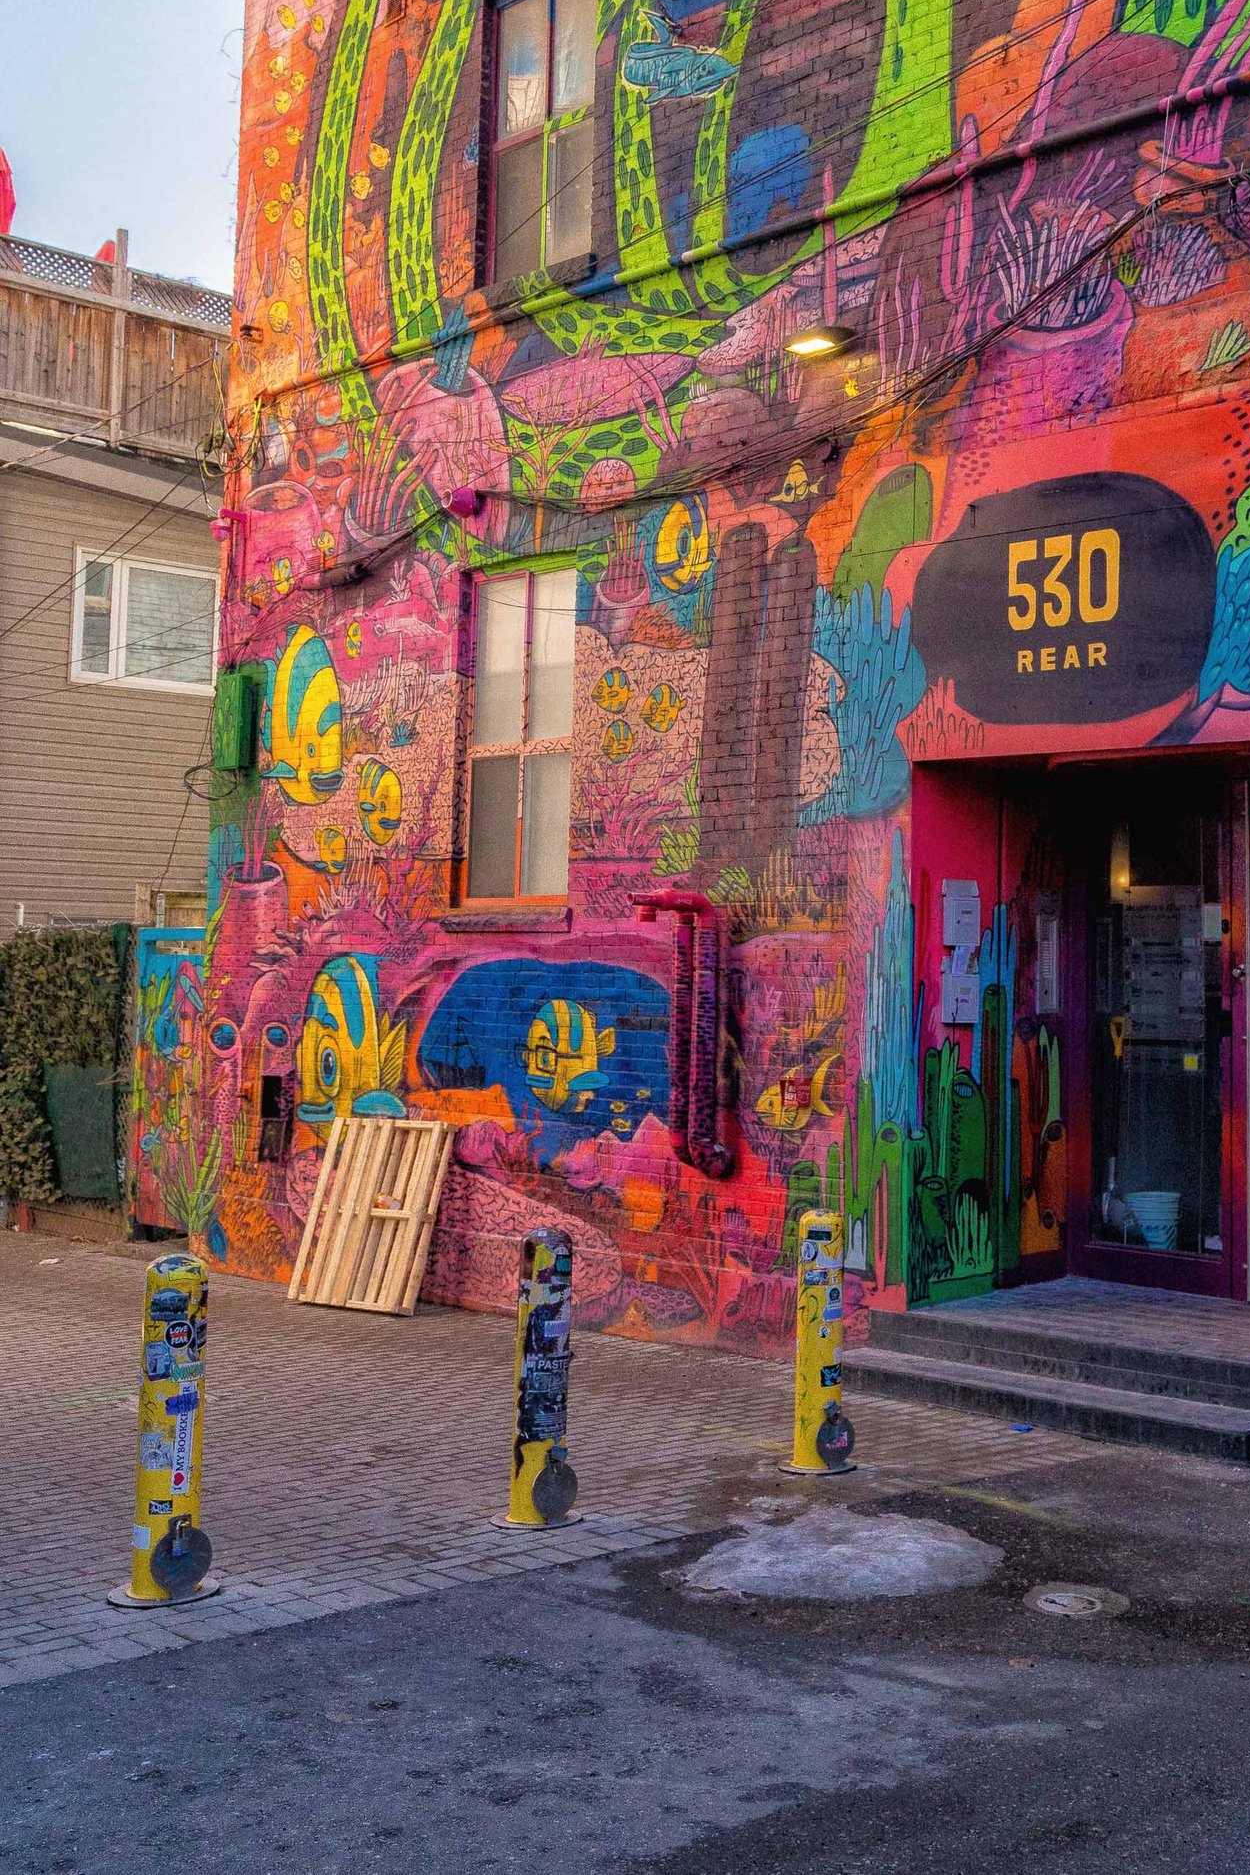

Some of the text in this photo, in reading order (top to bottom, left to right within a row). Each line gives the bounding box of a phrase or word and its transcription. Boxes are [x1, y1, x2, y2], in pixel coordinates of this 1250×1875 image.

[1008, 528, 1120, 631] 530
[1017, 642, 1107, 673] REAR
[169, 1325, 189, 1335] LOVE
[170, 1336, 189, 1345] FEAR
[177, 1385, 191, 1452] BOOKKER
[175, 1453, 186, 1472] MY
